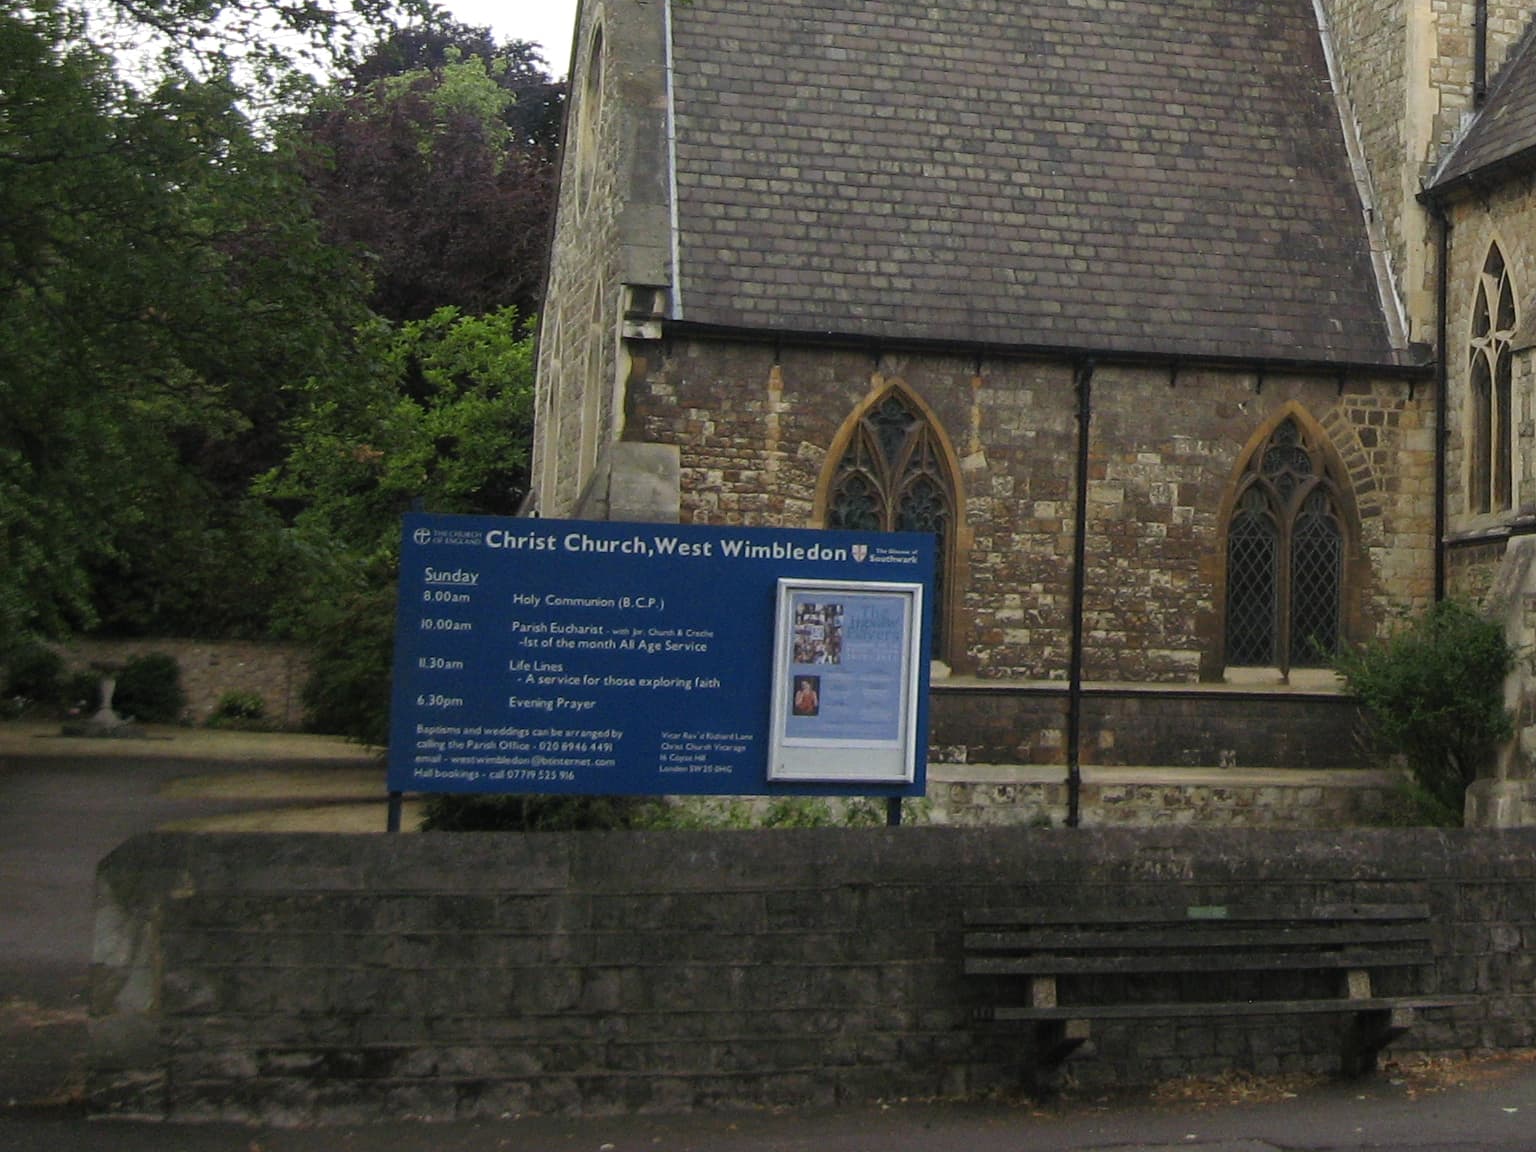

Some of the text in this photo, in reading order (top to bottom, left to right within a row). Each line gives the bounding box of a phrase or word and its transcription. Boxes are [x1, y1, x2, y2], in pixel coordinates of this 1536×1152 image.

[486, 529, 557, 550] Christ
[720, 539, 847, 561] Wimbledon
[425, 567, 479, 584] Sunday
[423, 590, 664, 611] 8.00am Holy Communion (B.C.P.)
[421, 618, 472, 631] 10.00am
[512, 621, 548, 633] Parish
[550, 622, 604, 635] Eucharist
[541, 636, 554, 648] of
[556, 637, 576, 649] the
[578, 638, 616, 650] month
[619, 639, 636, 650] All
[638, 639, 661, 653] Age
[665, 639, 708, 653] Service
[509, 660, 531, 671] Life
[534, 660, 563, 672] Lines
[525, 674, 535, 684] A
[538, 675, 580, 686] service
[583, 675, 601, 686] for
[603, 676, 636, 687] those
[639, 677, 692, 690] exploring
[695, 676, 720, 688] faith
[417, 695, 596, 712] 6.30pm Evening Prayer
[565, 729, 609, 740] arranged
[611, 730, 623, 740] by
